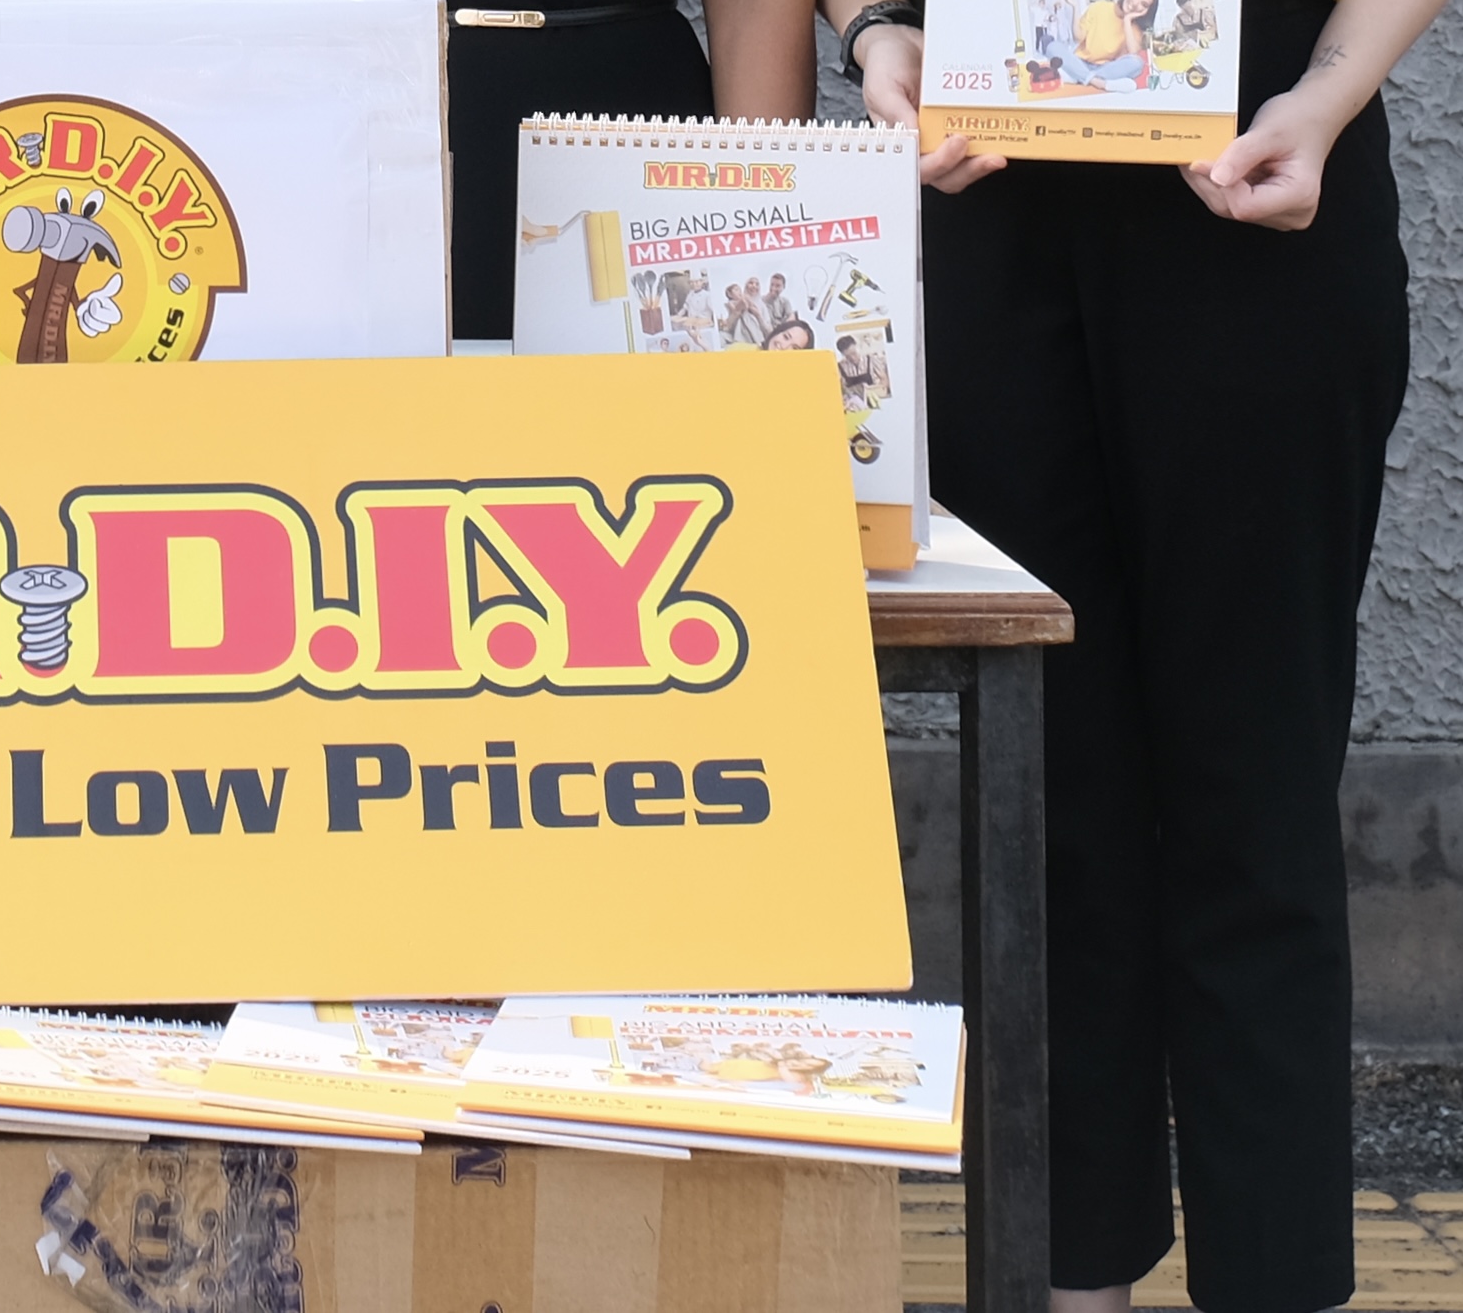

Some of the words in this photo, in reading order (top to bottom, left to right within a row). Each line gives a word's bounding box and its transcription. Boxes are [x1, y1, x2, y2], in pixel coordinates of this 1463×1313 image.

[942, 72, 993, 90] 2025
[630, 219, 669, 241] BIG
[676, 212, 727, 236] AND
[733, 203, 814, 228] SMALL
[635, 235, 741, 263] MR.D.I.Y.
[744, 227, 795, 252] HAS
[800, 224, 826, 246] IT
[829, 218, 875, 240] ALL
[9, 748, 290, 839] Low
[323, 740, 772, 834] Prices
